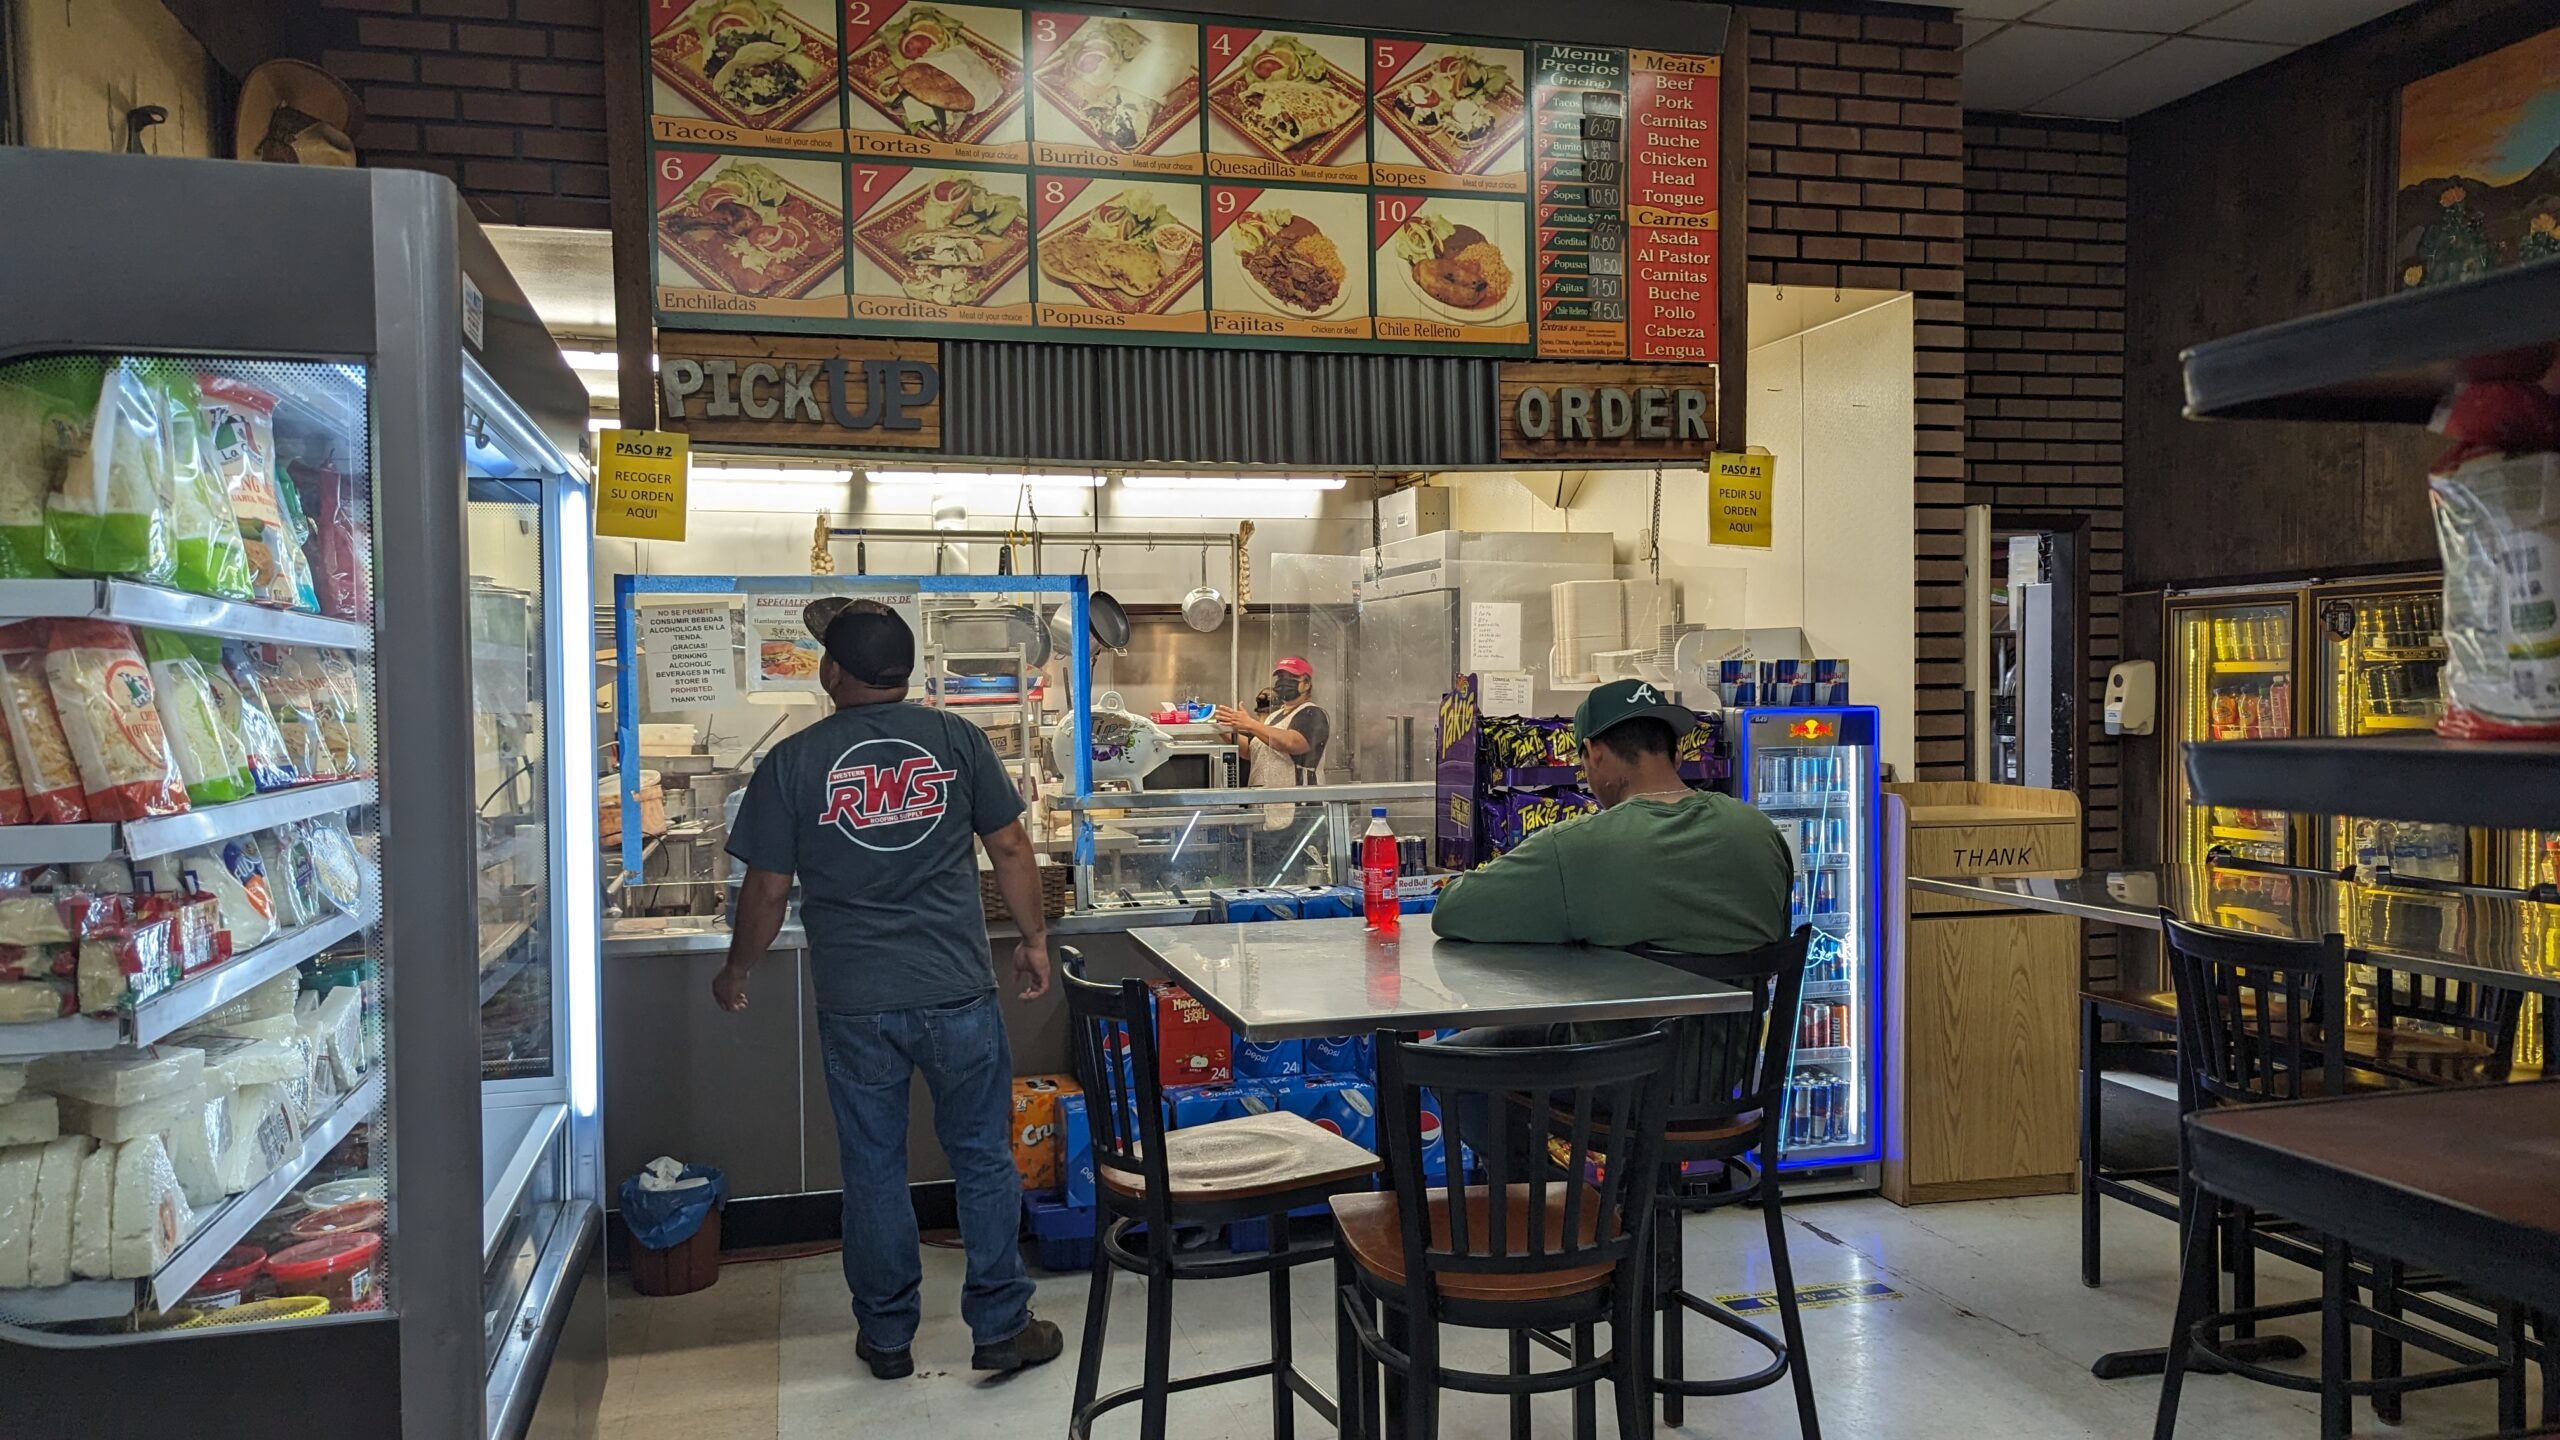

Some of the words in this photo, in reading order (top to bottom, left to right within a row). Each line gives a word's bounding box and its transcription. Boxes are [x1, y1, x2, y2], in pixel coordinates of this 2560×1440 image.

[851, 2, 871, 25] 2
[1037, 20, 1058, 42] 3
[1212, 33, 1232, 56] 4
[1377, 47, 1396, 68] 5
[1551, 47, 1610, 62] Menu
[1541, 59, 1620, 76] Precios
[1646, 56, 1706, 74] Meats
[1551, 73, 1611, 89] (Pricing)
[1656, 76, 1694, 91] Beef
[1553, 98, 1580, 107] Tacos
[1656, 95, 1694, 110] Pork
[1553, 120, 1581, 130] Tortas
[1640, 113, 1708, 130] Carnitas
[658, 121, 738, 142] Tacos
[765, 135, 783, 144] Meat
[784, 136, 792, 145] of
[792, 138, 809, 147] your
[810, 138, 833, 148] choice
[853, 135, 931, 155] Tortas
[1648, 133, 1700, 148] Buche
[955, 148, 971, 157] Meat
[980, 150, 996, 160] your
[997, 150, 1019, 160] choice
[1039, 149, 1119, 168] Burritos
[1640, 151, 1708, 168] Chicken
[661, 158, 684, 181] 6
[1132, 159, 1148, 168] Meat
[1157, 161, 1171, 171] your
[1172, 161, 1193, 171] choice
[1210, 159, 1296, 177] Quesadillas
[1540, 162, 1548, 171] 4
[859, 170, 879, 193] 7
[1301, 169, 1317, 179] Meat
[1325, 172, 1339, 182] your
[1340, 172, 1358, 181] choice
[1375, 169, 1426, 186] Sopes
[1652, 171, 1695, 186] Head
[1462, 178, 1478, 187] Meat
[1486, 181, 1498, 190] your
[1499, 180, 1517, 190] choice
[1045, 181, 1066, 204] 8
[1540, 185, 1548, 195] 5
[1553, 190, 1581, 201] Sopes
[1643, 190, 1704, 207] Tongue
[1216, 191, 1236, 213] 9
[1377, 200, 1407, 222] 10
[1540, 207, 1549, 217] 6
[1553, 213, 1587, 223] Enchiladas
[1639, 212, 1709, 227] Carnes
[1541, 232, 1549, 242] 7
[1554, 237, 1587, 247] Gorditas
[1649, 231, 1699, 245] Asada
[1542, 255, 1550, 265] 8
[1554, 259, 1587, 269] Popusas
[1637, 249, 1654, 262] Al
[1659, 250, 1711, 264] Pastor
[1640, 268, 1708, 283] Carnitas
[1542, 279, 1550, 288] 9
[1555, 283, 1584, 293] Fajitas
[1648, 287, 1700, 301] Buche
[664, 293, 756, 311] Enchiladas
[1542, 301, 1552, 311] 10
[858, 302, 948, 319] Gorditas
[959, 310, 975, 320] Meat
[984, 313, 1000, 323] your
[1001, 313, 1023, 322] choice
[1042, 308, 1126, 327] Popusas
[1654, 306, 1696, 320] Pollo
[1213, 315, 1285, 336] Fajitas
[1312, 325, 1336, 334] Chicken
[1345, 326, 1358, 335] Beef
[1378, 322, 1410, 338] Chile
[1413, 324, 1460, 339] Relleno
[1540, 323, 1568, 331] Extras
[1644, 324, 1705, 339] Cabeza
[1645, 342, 1706, 359] Lengua
[1517, 385, 1710, 440] ORDER
[616, 442, 652, 457] PASO
[656, 445, 673, 458] #2
[1721, 464, 1748, 475] PASO
[1750, 465, 1762, 476] #1
[615, 471, 672, 485] RECOGER
[611, 488, 628, 500] SU
[631, 489, 674, 503] ORDEN
[1719, 488, 1747, 499] PEDIR
[1749, 490, 1762, 500] SU
[626, 507, 658, 520] AQUI
[1723, 505, 1757, 517] ORDEN
[1728, 522, 1753, 533] AQUI
[682, 608, 714, 616] PERMITE
[650, 626, 702, 634] ALCOHOLICAS
[656, 669, 701, 678] BEVERAGES
[1626, 683, 1656, 704] A
[1440, 692, 1474, 760] Takis
[832, 769, 866, 780] WESTERN
[818, 756, 957, 829] RWS
[870, 814, 899, 824] ROOFING
[900, 810, 924, 820] SUPPLY
[1518, 803, 1560, 836] Takis
[1954, 848, 2032, 867] THANK
[1414, 878, 1428, 886] Bull
[1244, 1049, 1269, 1063] pepsi
[1318, 1043, 1341, 1057] pepsi
[1211, 1067, 1226, 1080] 24
[1283, 1062, 1297, 1074] 24
[1213, 1088, 1243, 1097] pepsi
[1016, 1099, 1027, 1110] 24
